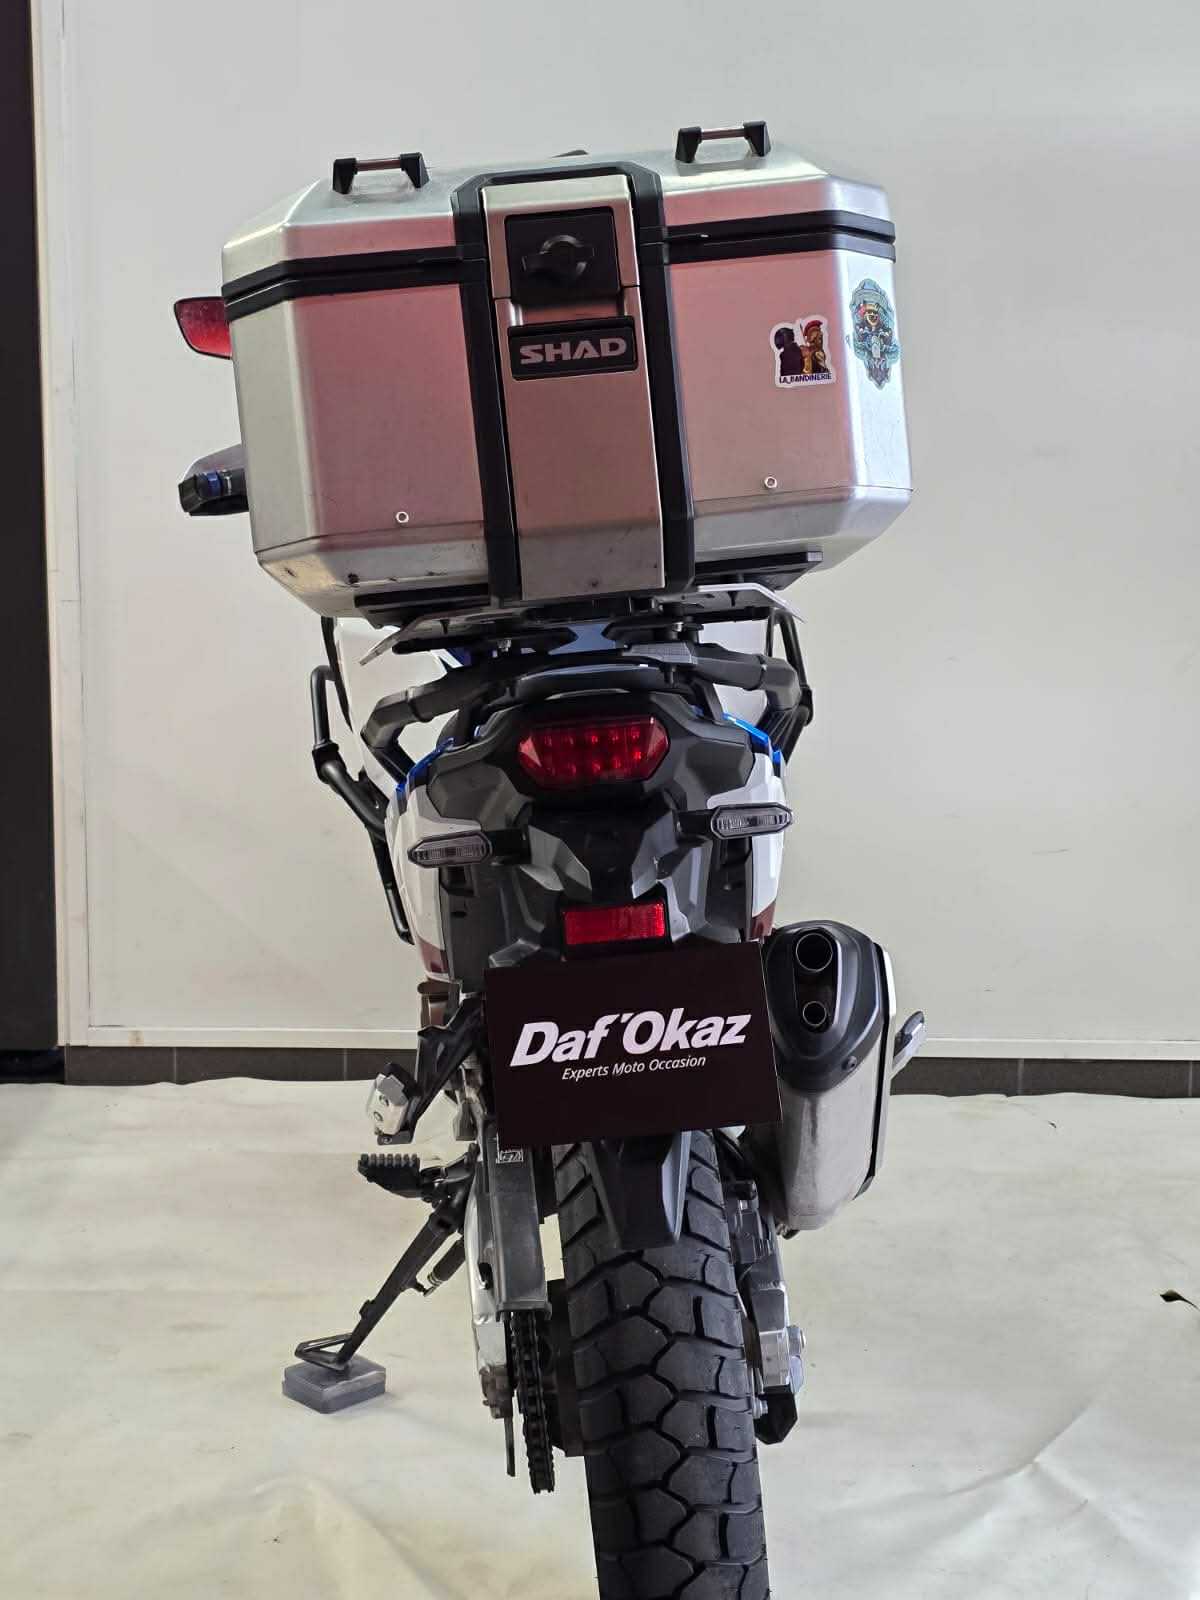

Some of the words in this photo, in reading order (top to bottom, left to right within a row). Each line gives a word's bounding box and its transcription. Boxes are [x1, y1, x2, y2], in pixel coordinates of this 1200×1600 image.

[520, 338, 627, 365] SHAD
[562, 1066, 609, 1082] Experts
[612, 1062, 645, 1076] Moto
[649, 1055, 706, 1072] Occasion
